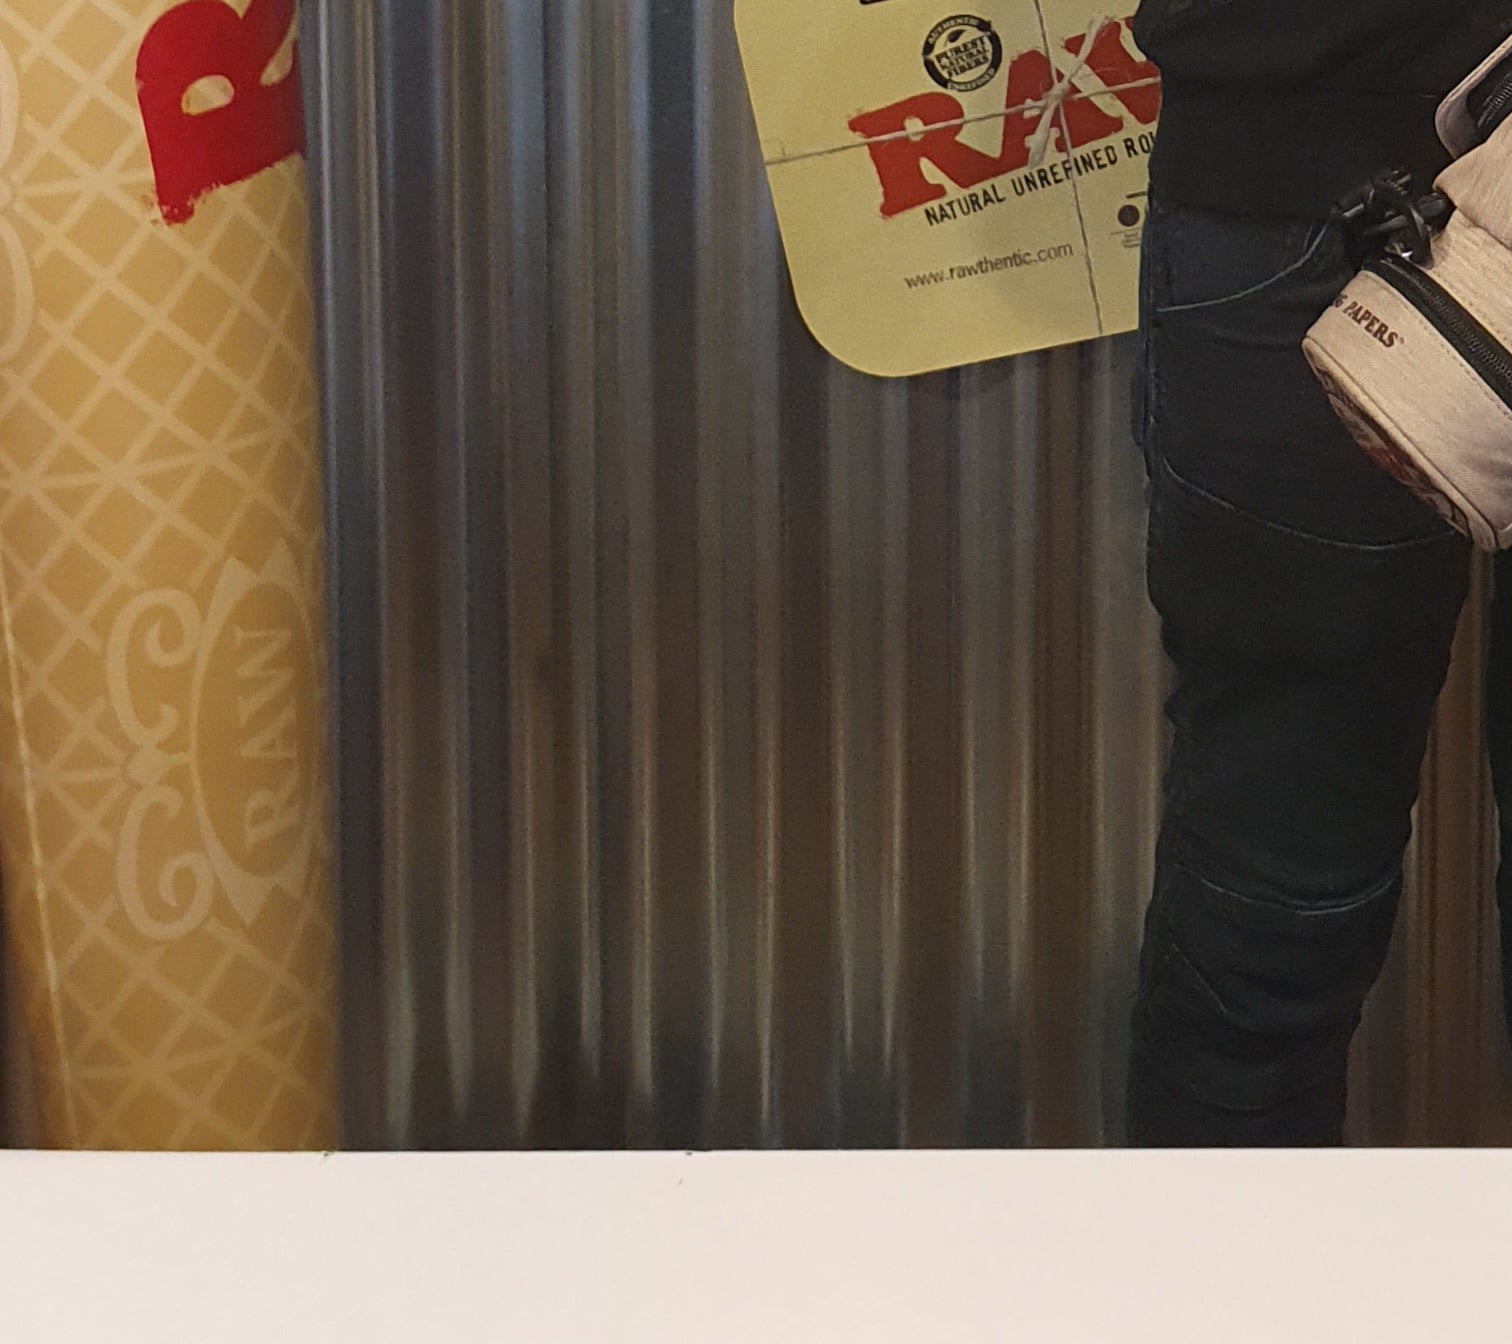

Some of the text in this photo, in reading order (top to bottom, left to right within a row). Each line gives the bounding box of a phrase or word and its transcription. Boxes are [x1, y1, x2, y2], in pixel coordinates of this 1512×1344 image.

[925, 149, 1119, 227] NATURAL UNREFINED
[903, 239, 1073, 290] www.rawthentic.com
[1342, 298, 1399, 350] PAPERS
[234, 624, 300, 851] RAW
